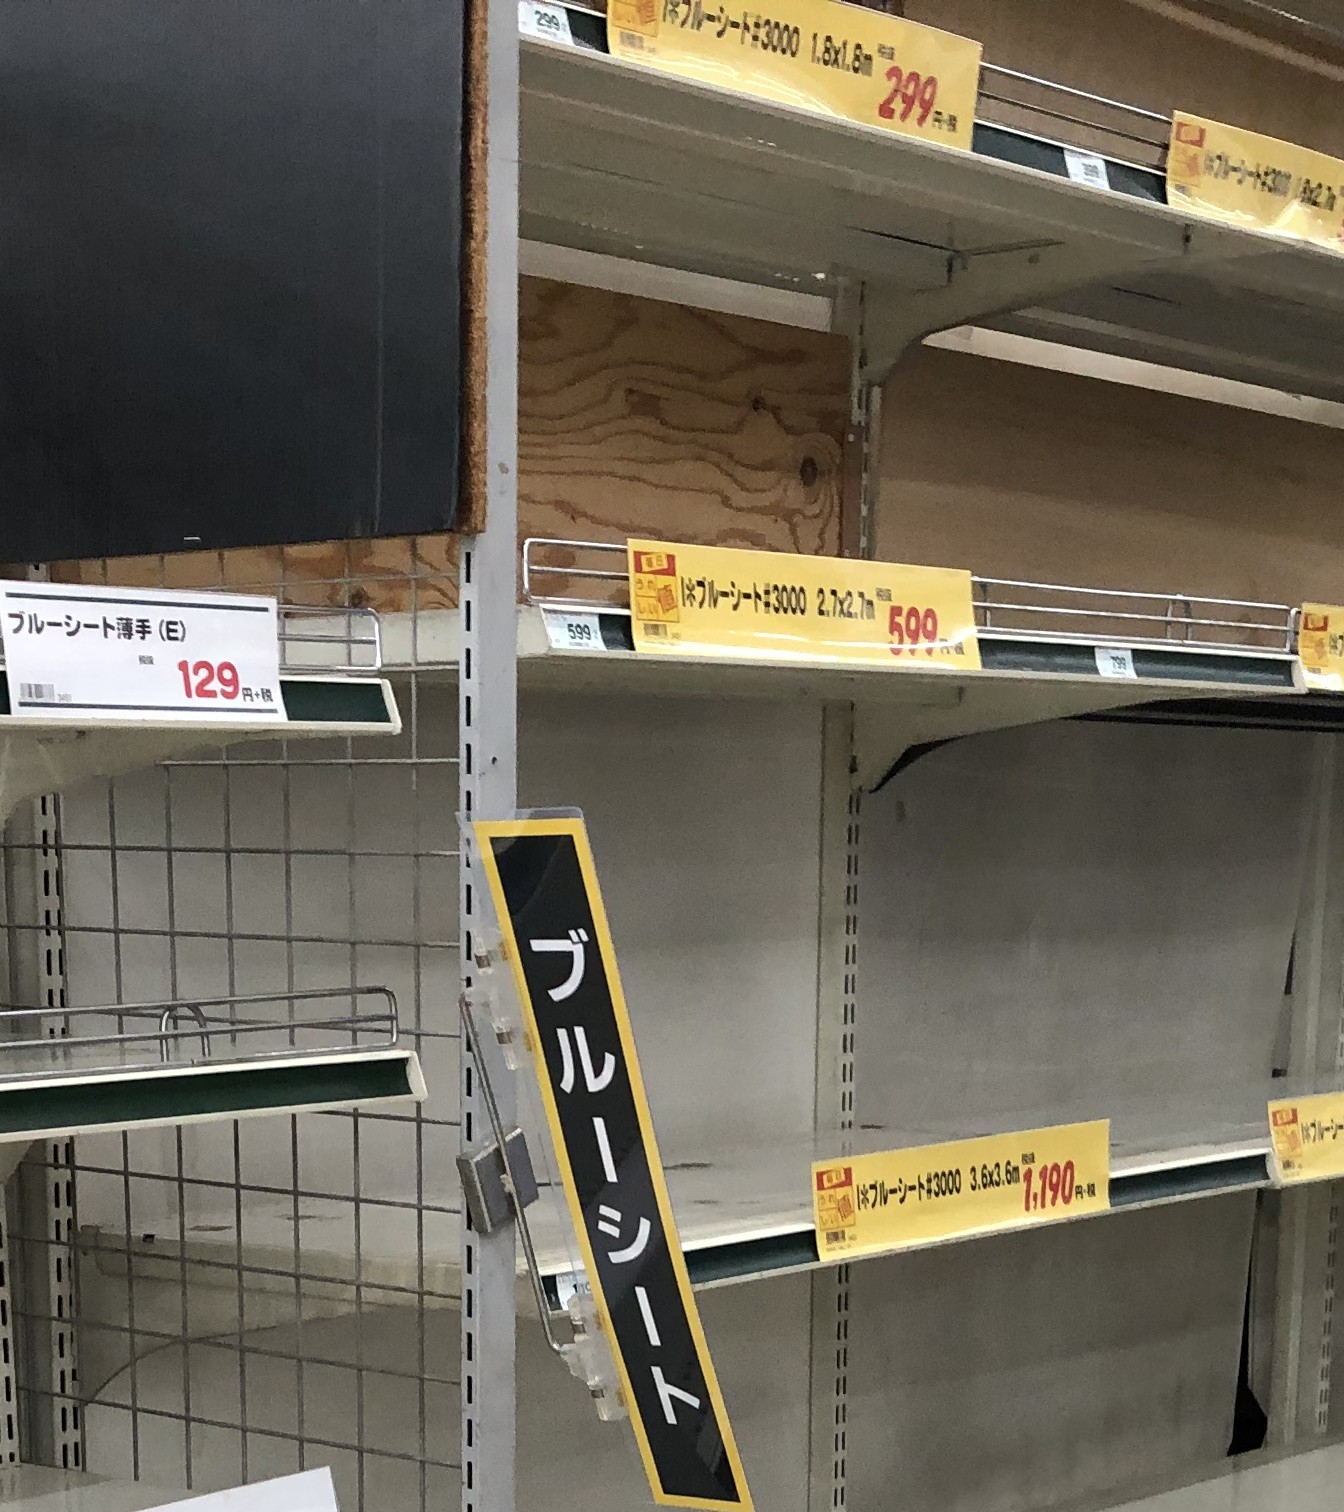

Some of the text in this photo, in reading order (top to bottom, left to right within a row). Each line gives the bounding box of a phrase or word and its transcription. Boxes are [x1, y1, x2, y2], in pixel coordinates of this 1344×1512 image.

[878, 65, 939, 128] 299
[566, 623, 592, 642] 599
[888, 604, 939, 657] 599
[177, 659, 238, 701] 129
[528, 926, 701, 1426] ブルーシート
[969, 1159, 1020, 1191] 3.6x3.6m
[1022, 1159, 1075, 1213] 1,190
